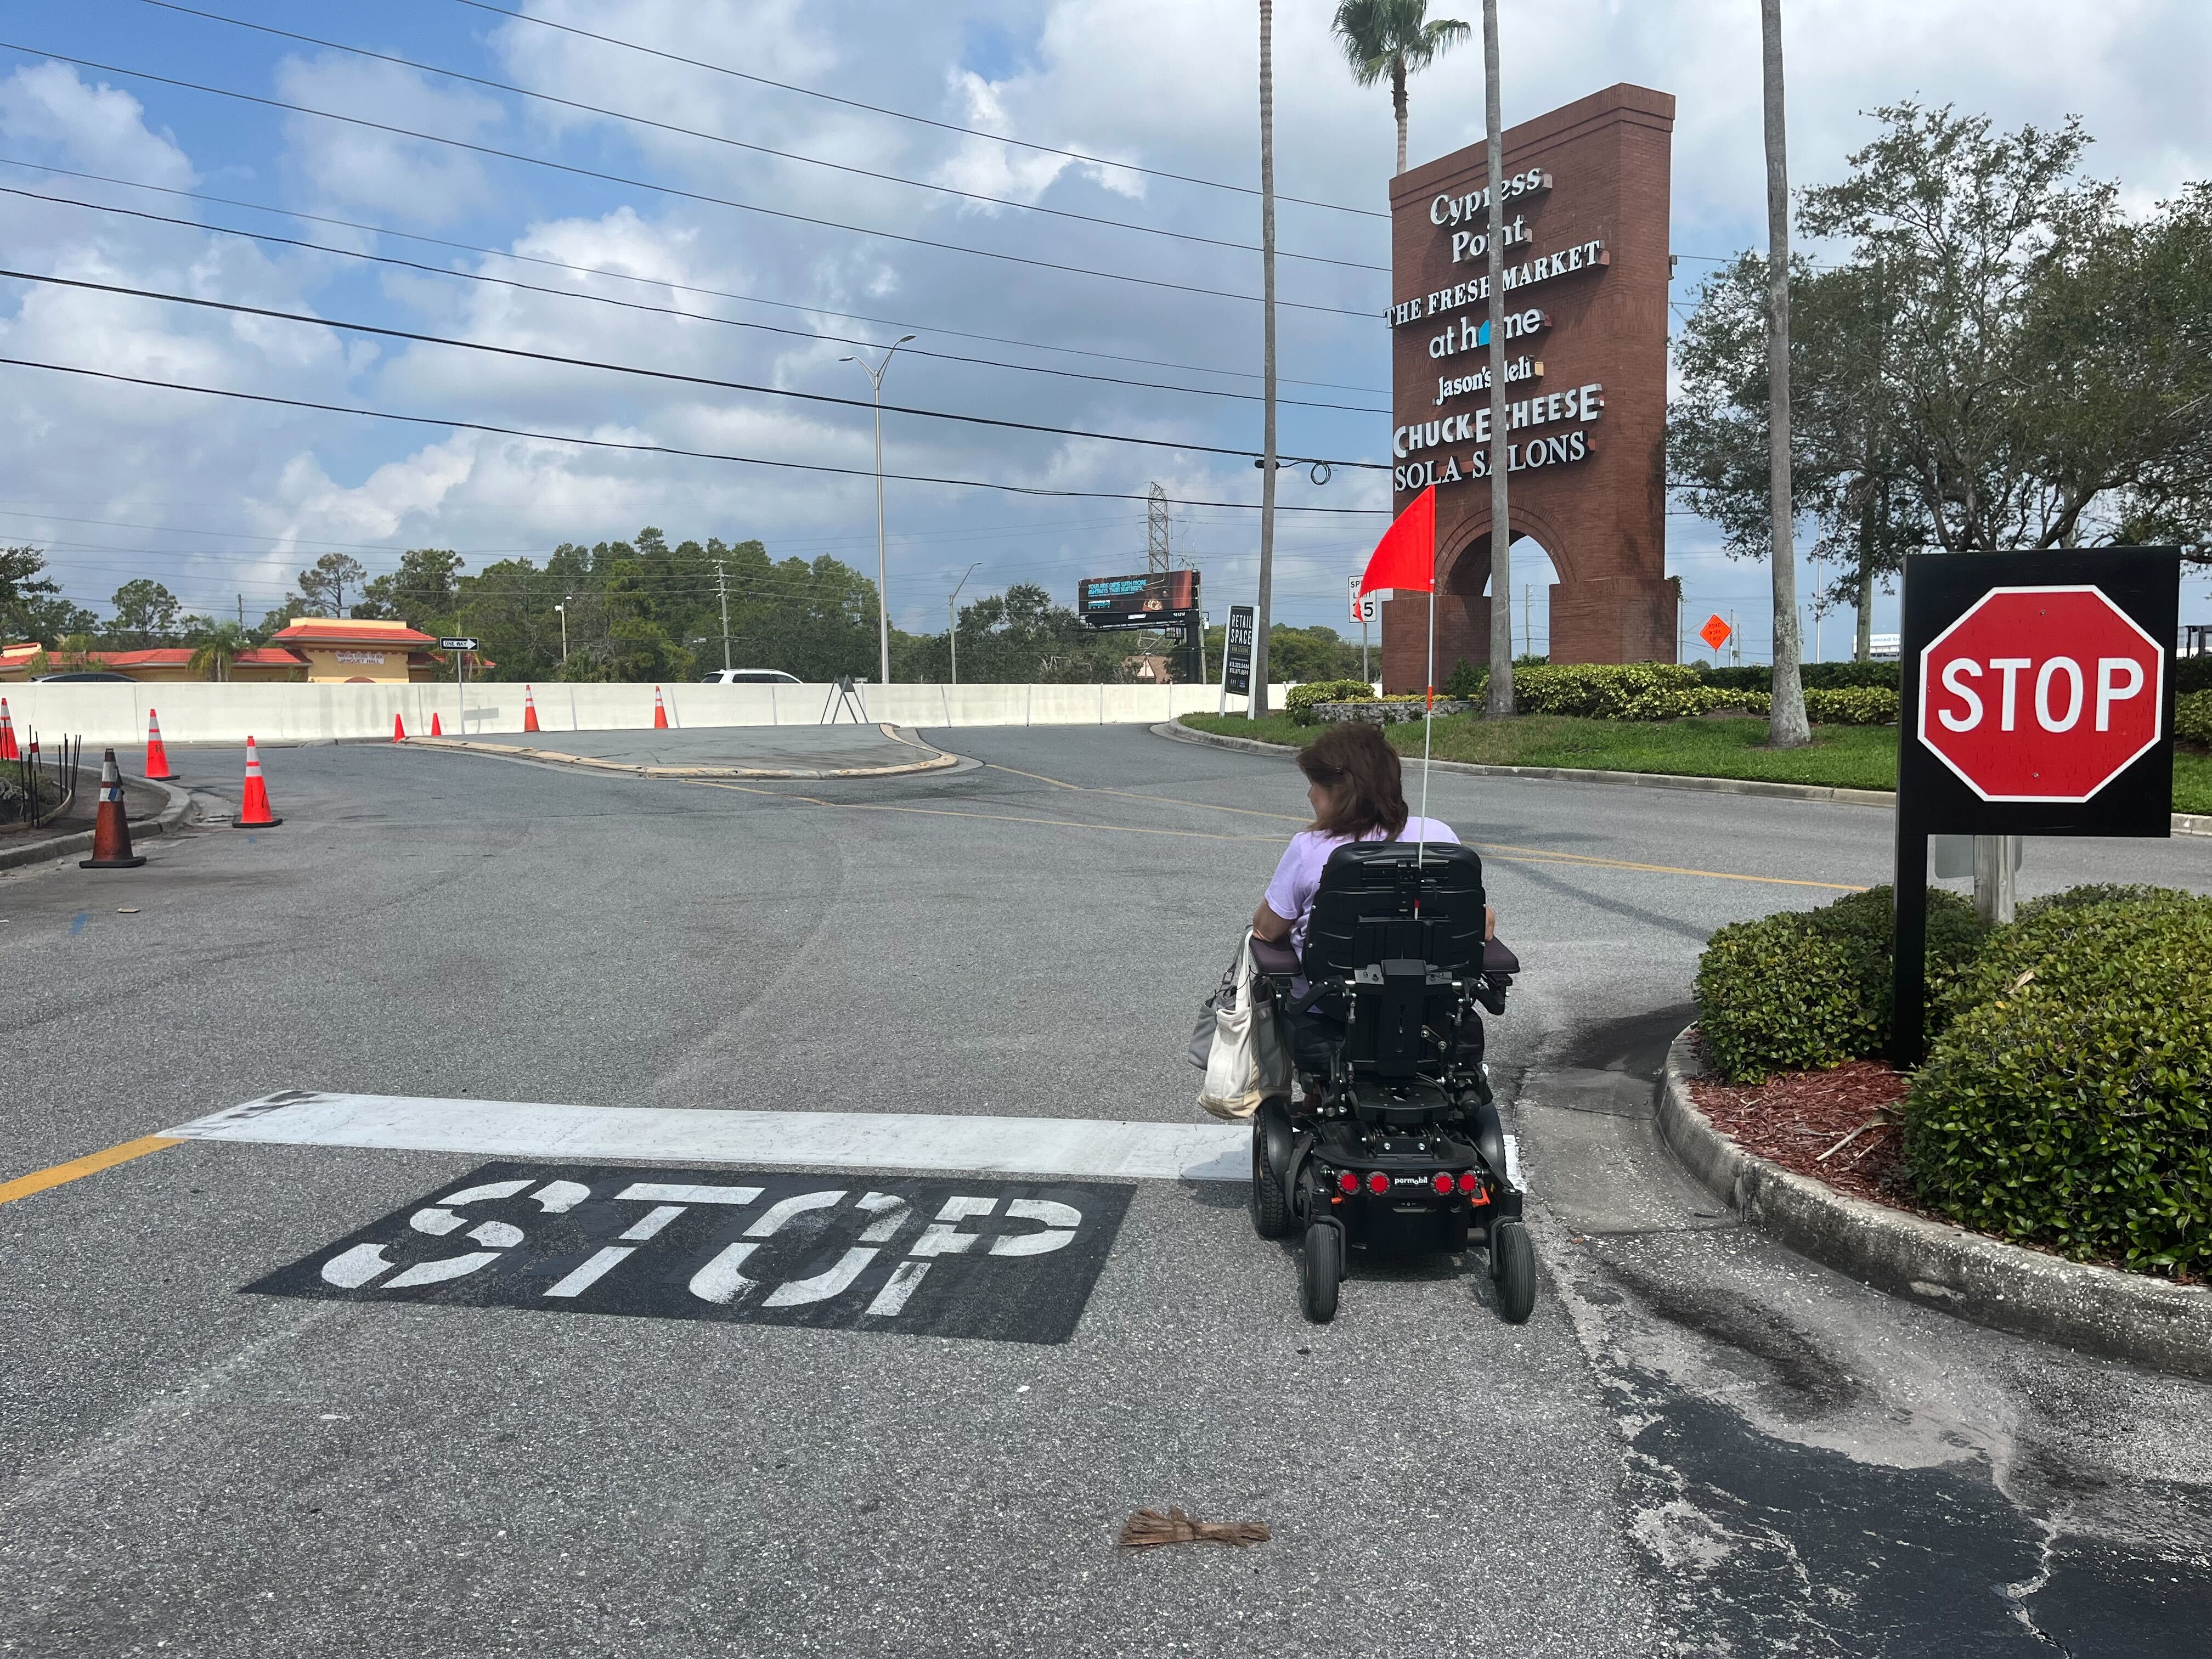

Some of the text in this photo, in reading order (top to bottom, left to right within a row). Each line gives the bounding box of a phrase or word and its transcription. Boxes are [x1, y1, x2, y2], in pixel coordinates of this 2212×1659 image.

[1383, 240, 1600, 328] THE FRESH MARKET
[1429, 326, 1454, 359] at
[1436, 366, 1492, 405] Jason's
[1393, 413, 1471, 458] CHUCK
[1505, 383, 1599, 431] HEESE
[1395, 431, 1585, 492] SOLA SLONS
[1231, 614, 1252, 629] RETAIL
[1231, 628, 1252, 645] SPACE
[1938, 656, 2145, 733] STOP
[1394, 1176, 1428, 1185] permobil
[321, 1179, 1082, 1317] STOP
